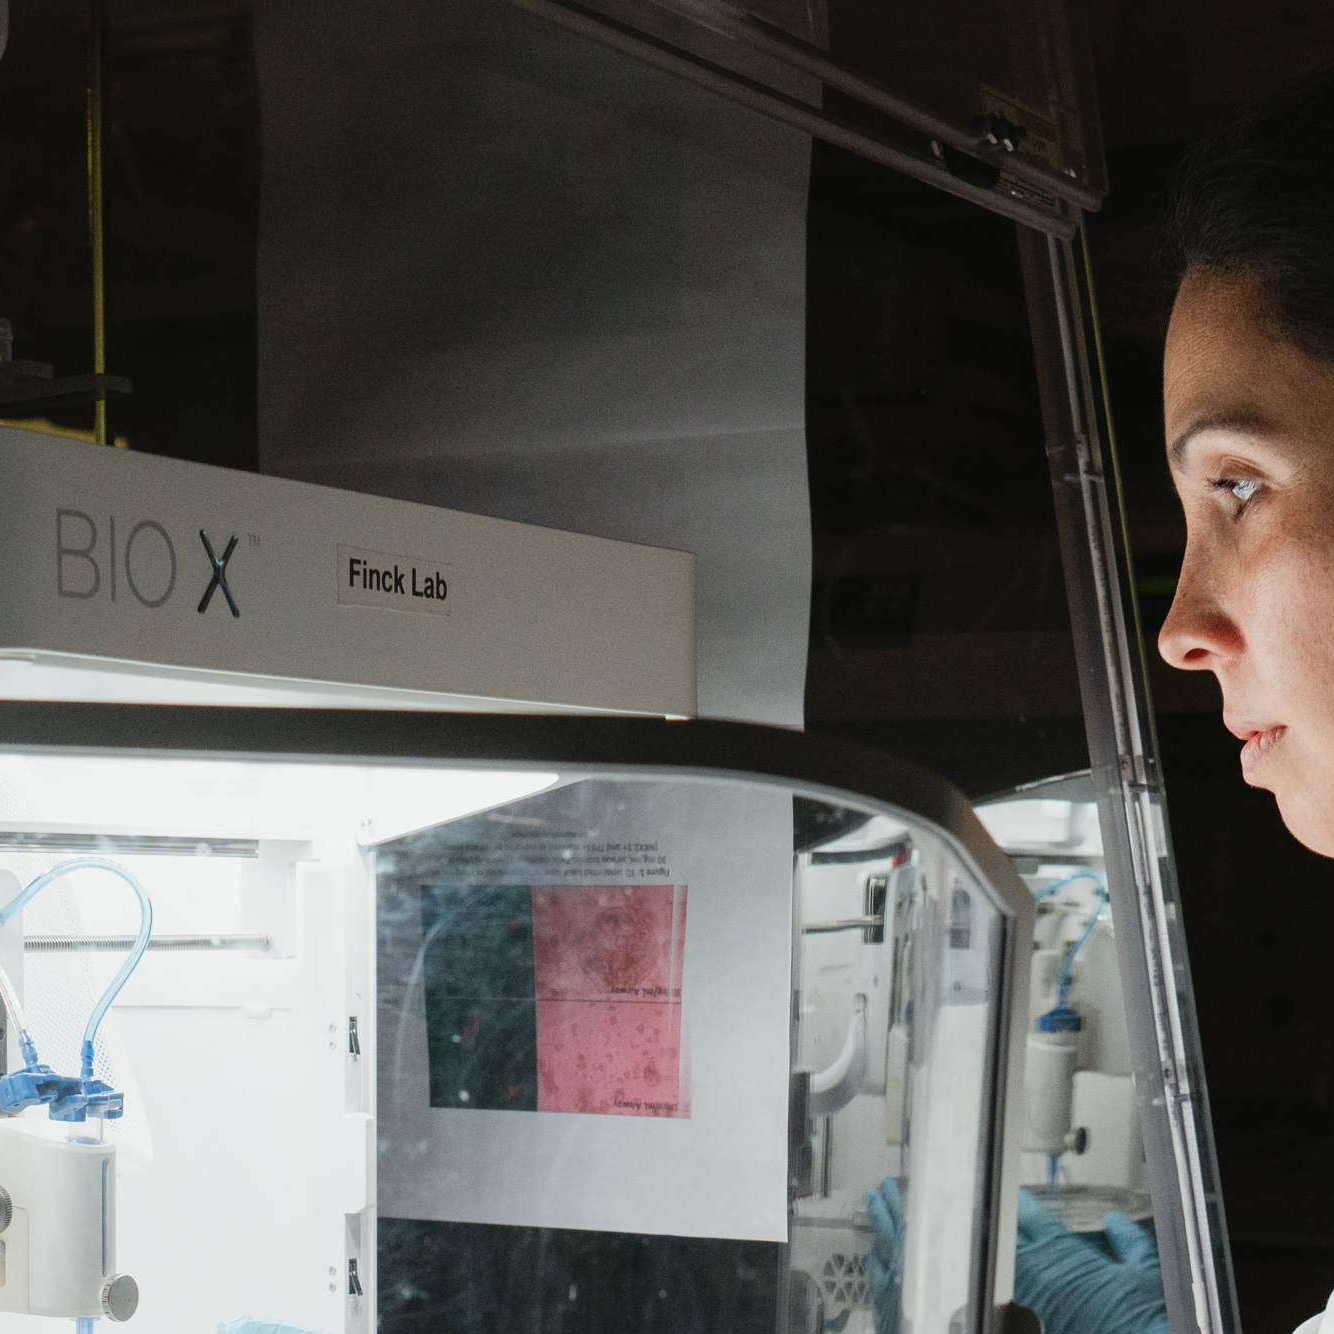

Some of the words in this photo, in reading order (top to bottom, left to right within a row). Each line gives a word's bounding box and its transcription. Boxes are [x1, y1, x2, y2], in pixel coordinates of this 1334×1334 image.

[56, 508, 177, 609] BIO
[197, 528, 240, 618] X
[349, 558, 405, 595] Finck
[412, 568, 447, 600] Lab
[647, 868, 670, 878] Figure
